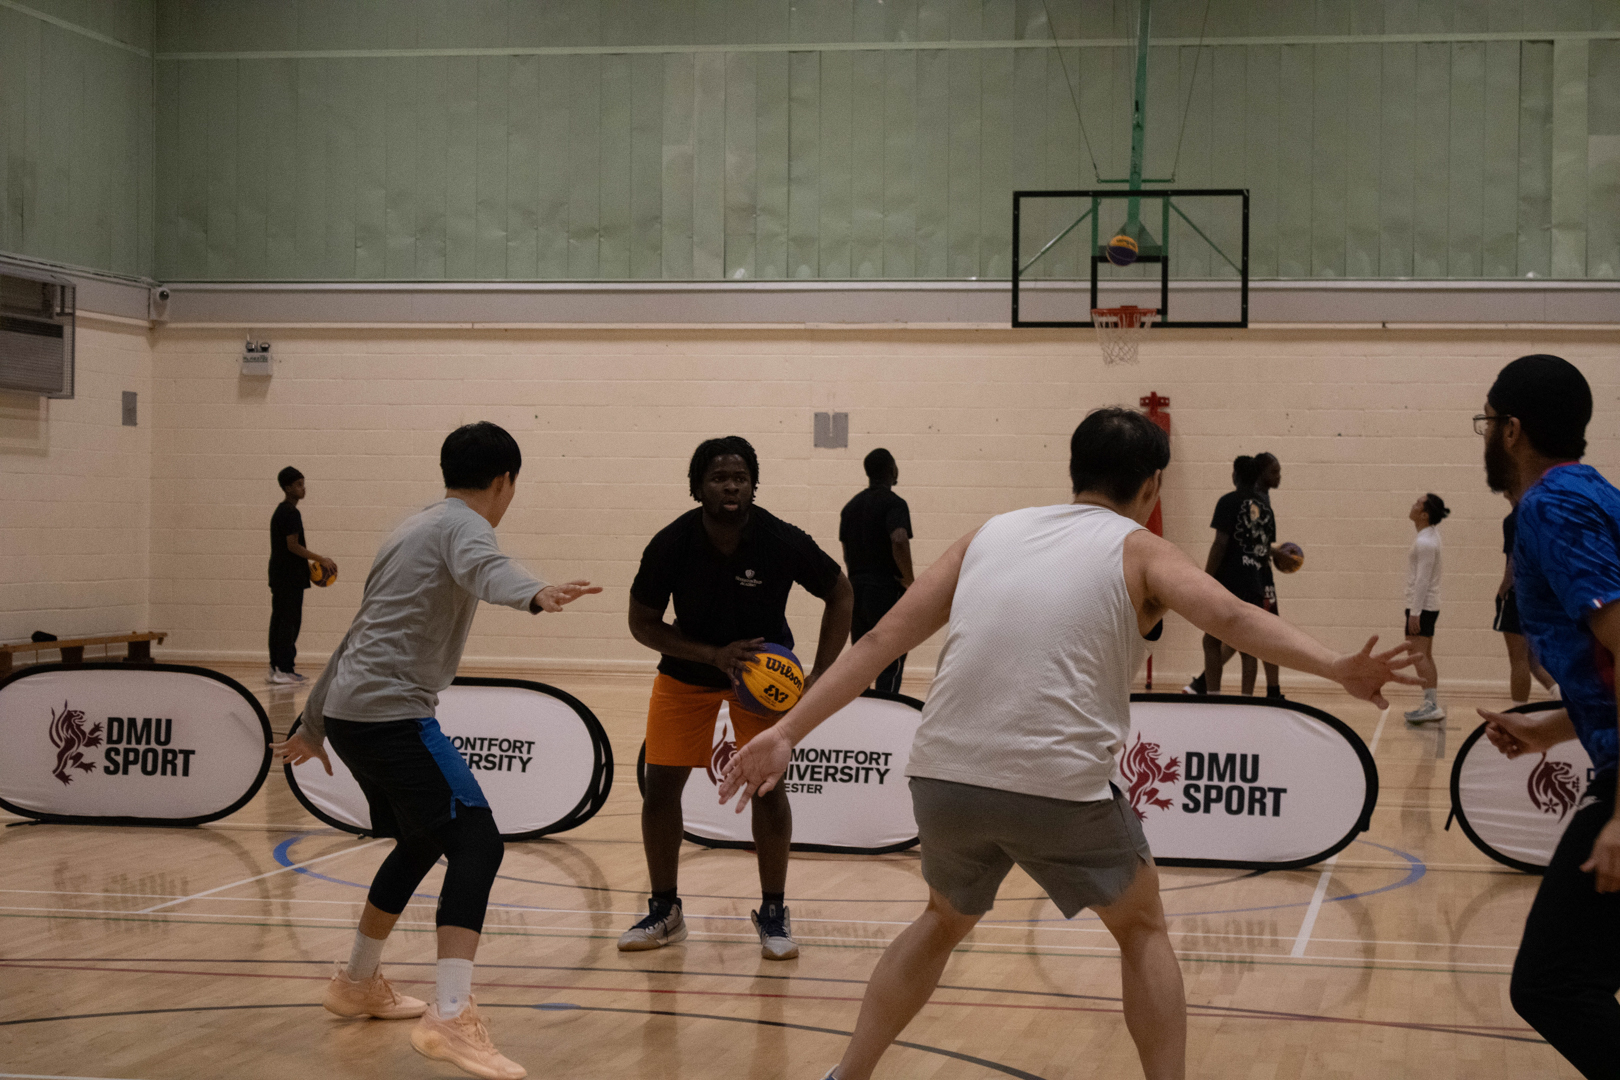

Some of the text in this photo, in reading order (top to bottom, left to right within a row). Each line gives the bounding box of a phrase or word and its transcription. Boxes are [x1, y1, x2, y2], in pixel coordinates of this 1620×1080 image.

[765, 656, 803, 691] Wilson
[106, 716, 173, 747] DMU
[445, 736, 535, 755] ONTFORT
[103, 746, 196, 777] SPORT
[459, 752, 533, 773] RSITY
[789, 748, 893, 766] MONTFORT
[1184, 751, 1260, 784] DMU
[783, 763, 891, 785] IVERSITY
[1181, 783, 1288, 817] SPORT
